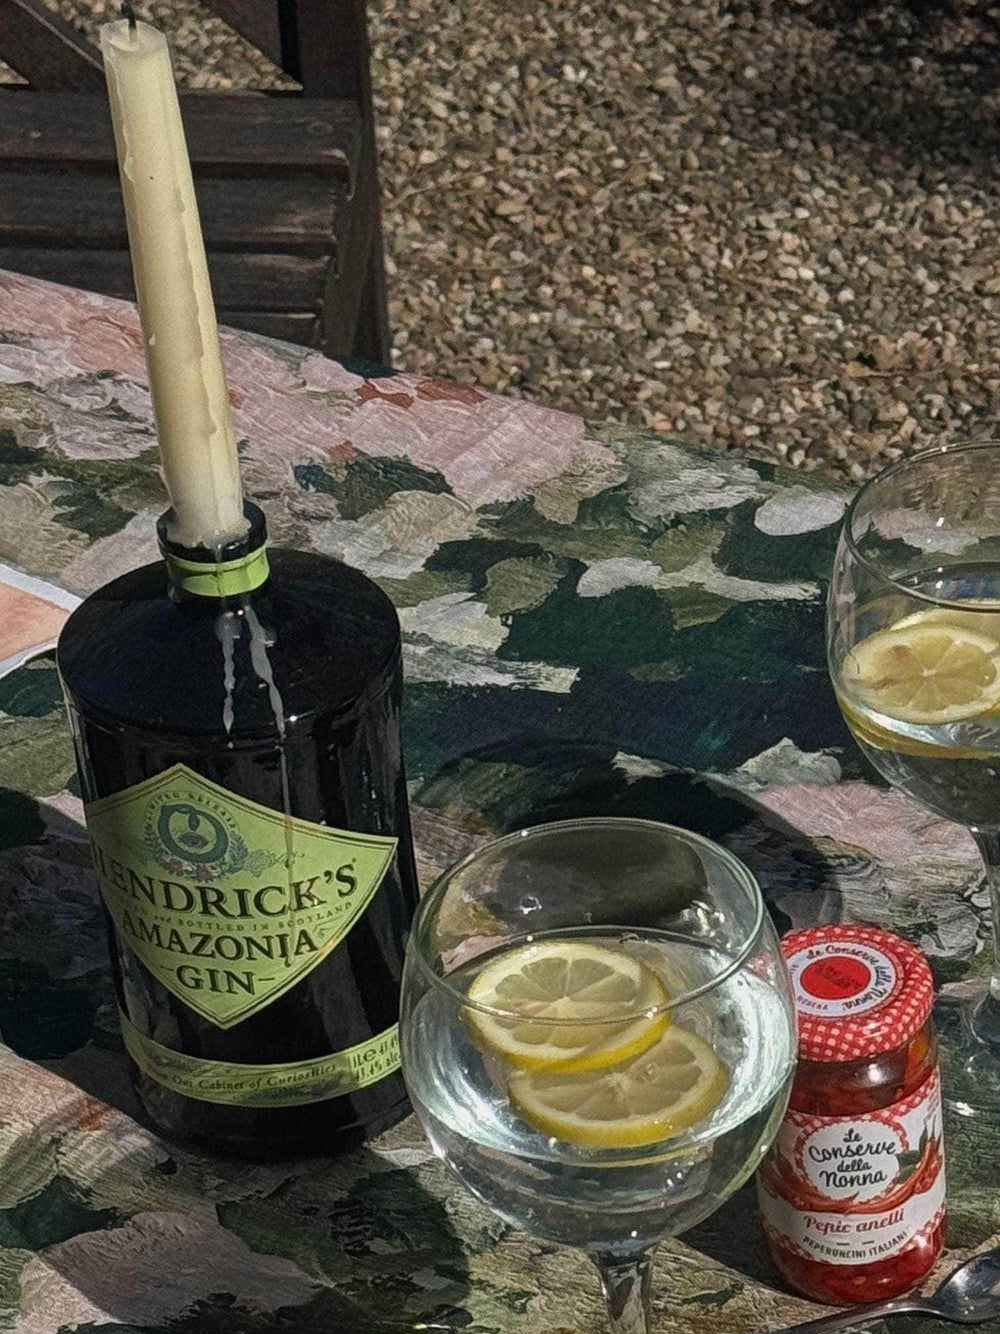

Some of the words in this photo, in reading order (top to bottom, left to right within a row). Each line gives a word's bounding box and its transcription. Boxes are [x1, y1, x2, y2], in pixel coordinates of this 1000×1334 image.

[278, 901, 353, 929] SCOTLAND
[122, 909, 319, 961] AMAZONIA
[175, 965, 256, 996] GIN
[198, 1079, 244, 1090] Cabinet
[842, 1128, 863, 1143] Le
[808, 1141, 896, 1163] Conserve
[837, 1158, 873, 1173] della
[818, 1170, 888, 1188] Nonna
[855, 1208, 905, 1233] anelli
[802, 1235, 867, 1259] PEPERONCINI
[868, 1230, 908, 1257] ITALIANI
